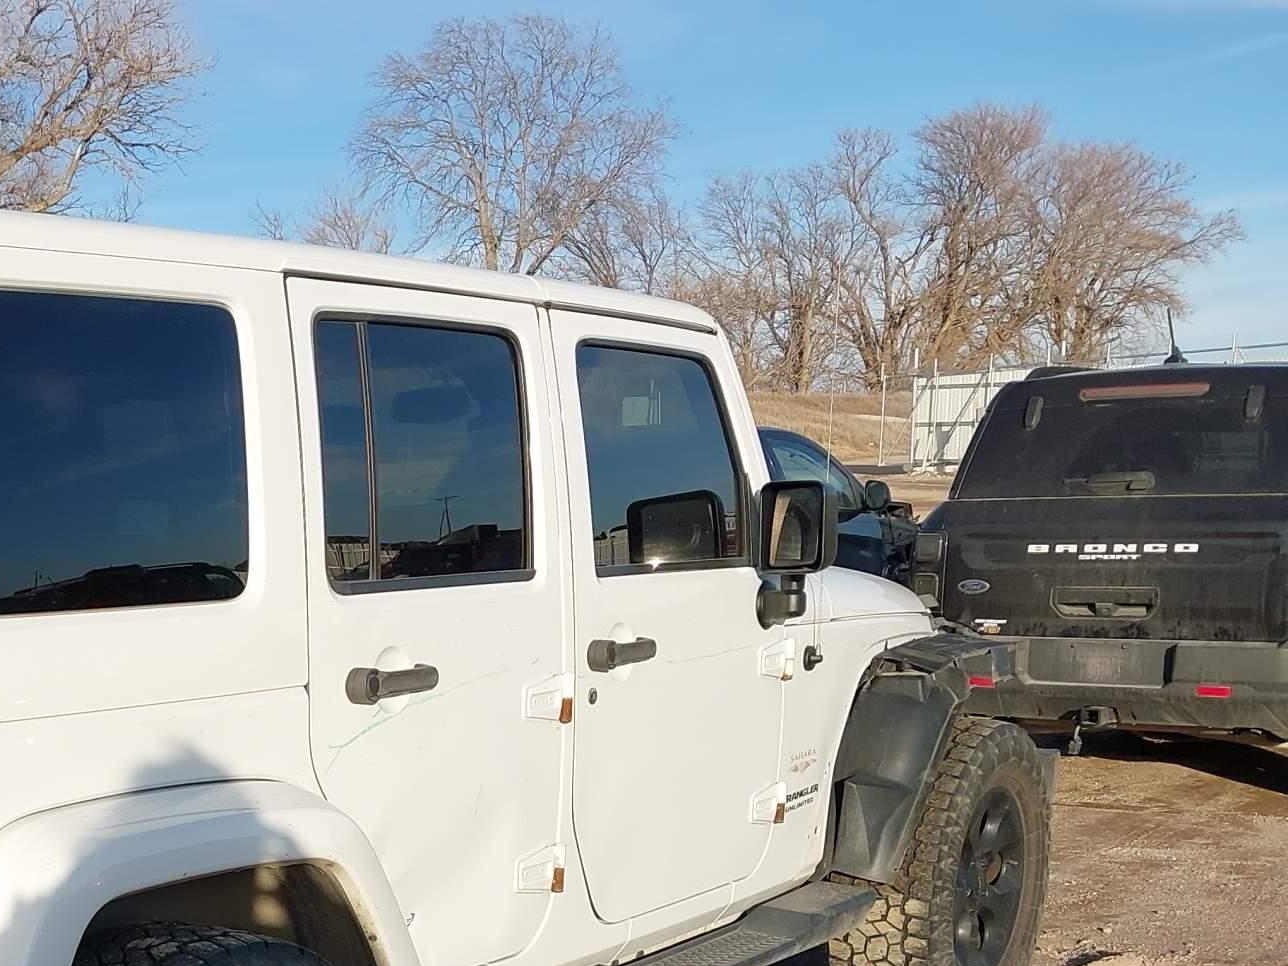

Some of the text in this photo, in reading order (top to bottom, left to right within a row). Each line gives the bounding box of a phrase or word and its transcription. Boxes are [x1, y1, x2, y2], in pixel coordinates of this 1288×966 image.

[1027, 543, 1199, 553] BRONCO
[791, 747, 816, 761] SAHARA
[785, 783, 819, 804] RANGLER
[785, 797, 814, 813] UNLIMITED
